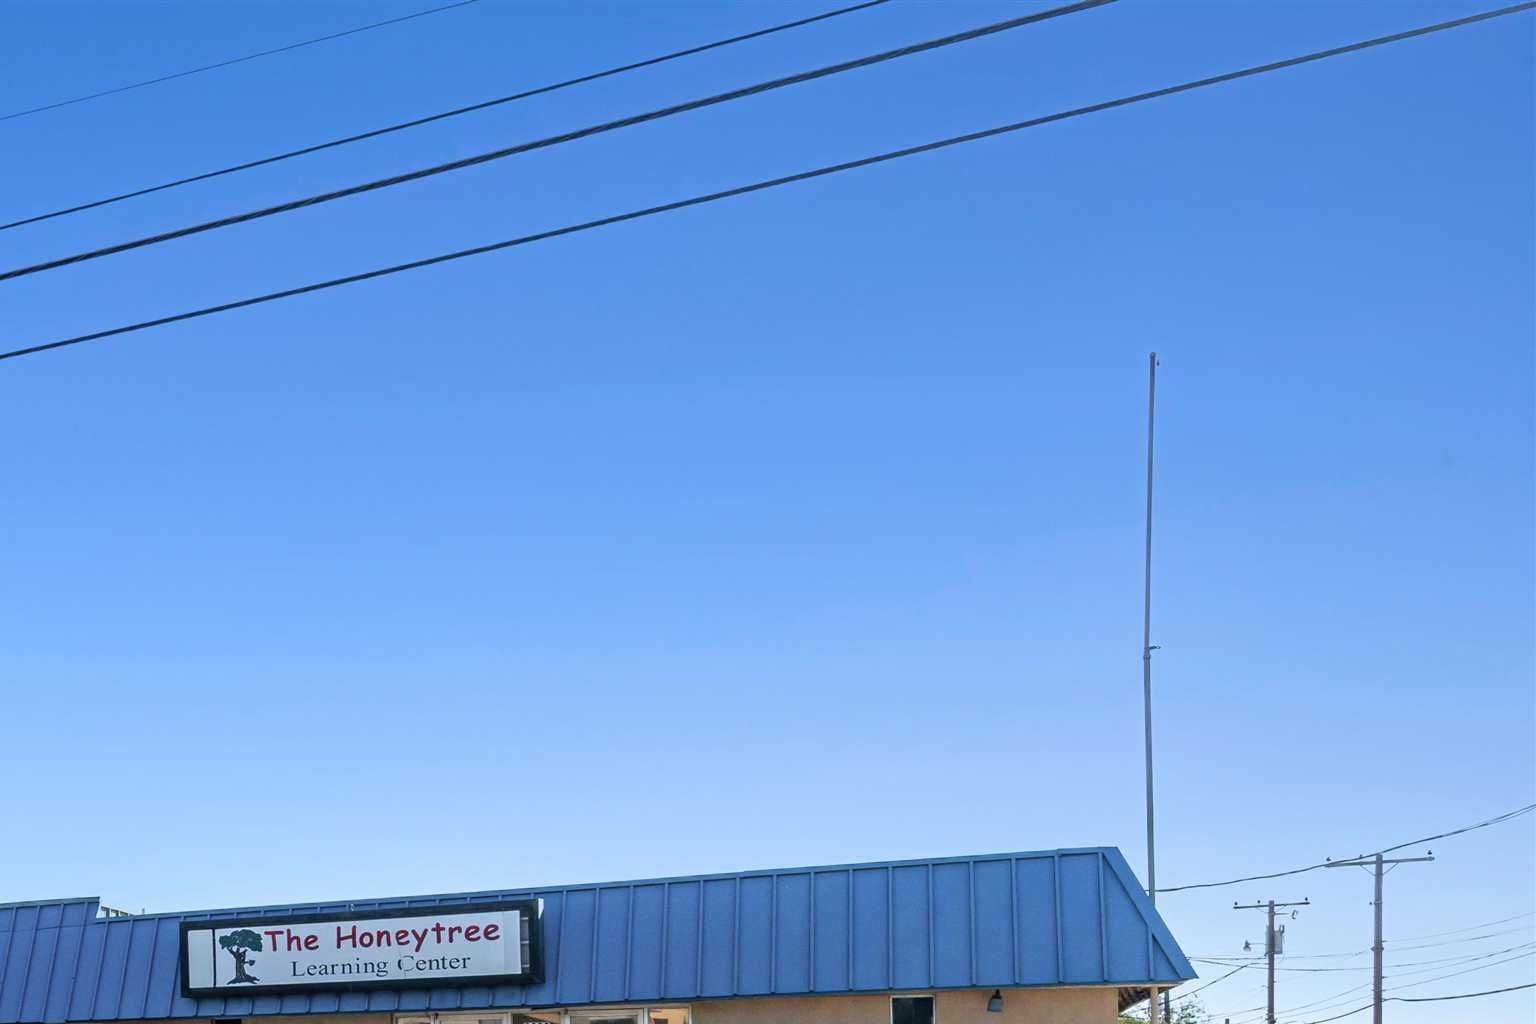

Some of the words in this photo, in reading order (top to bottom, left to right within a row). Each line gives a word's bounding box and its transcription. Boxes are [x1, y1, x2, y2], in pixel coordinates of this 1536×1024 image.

[264, 928, 320, 952] The
[336, 922, 501, 952] Honeytree
[291, 957, 389, 978] Learning
[397, 954, 472, 972] Center
